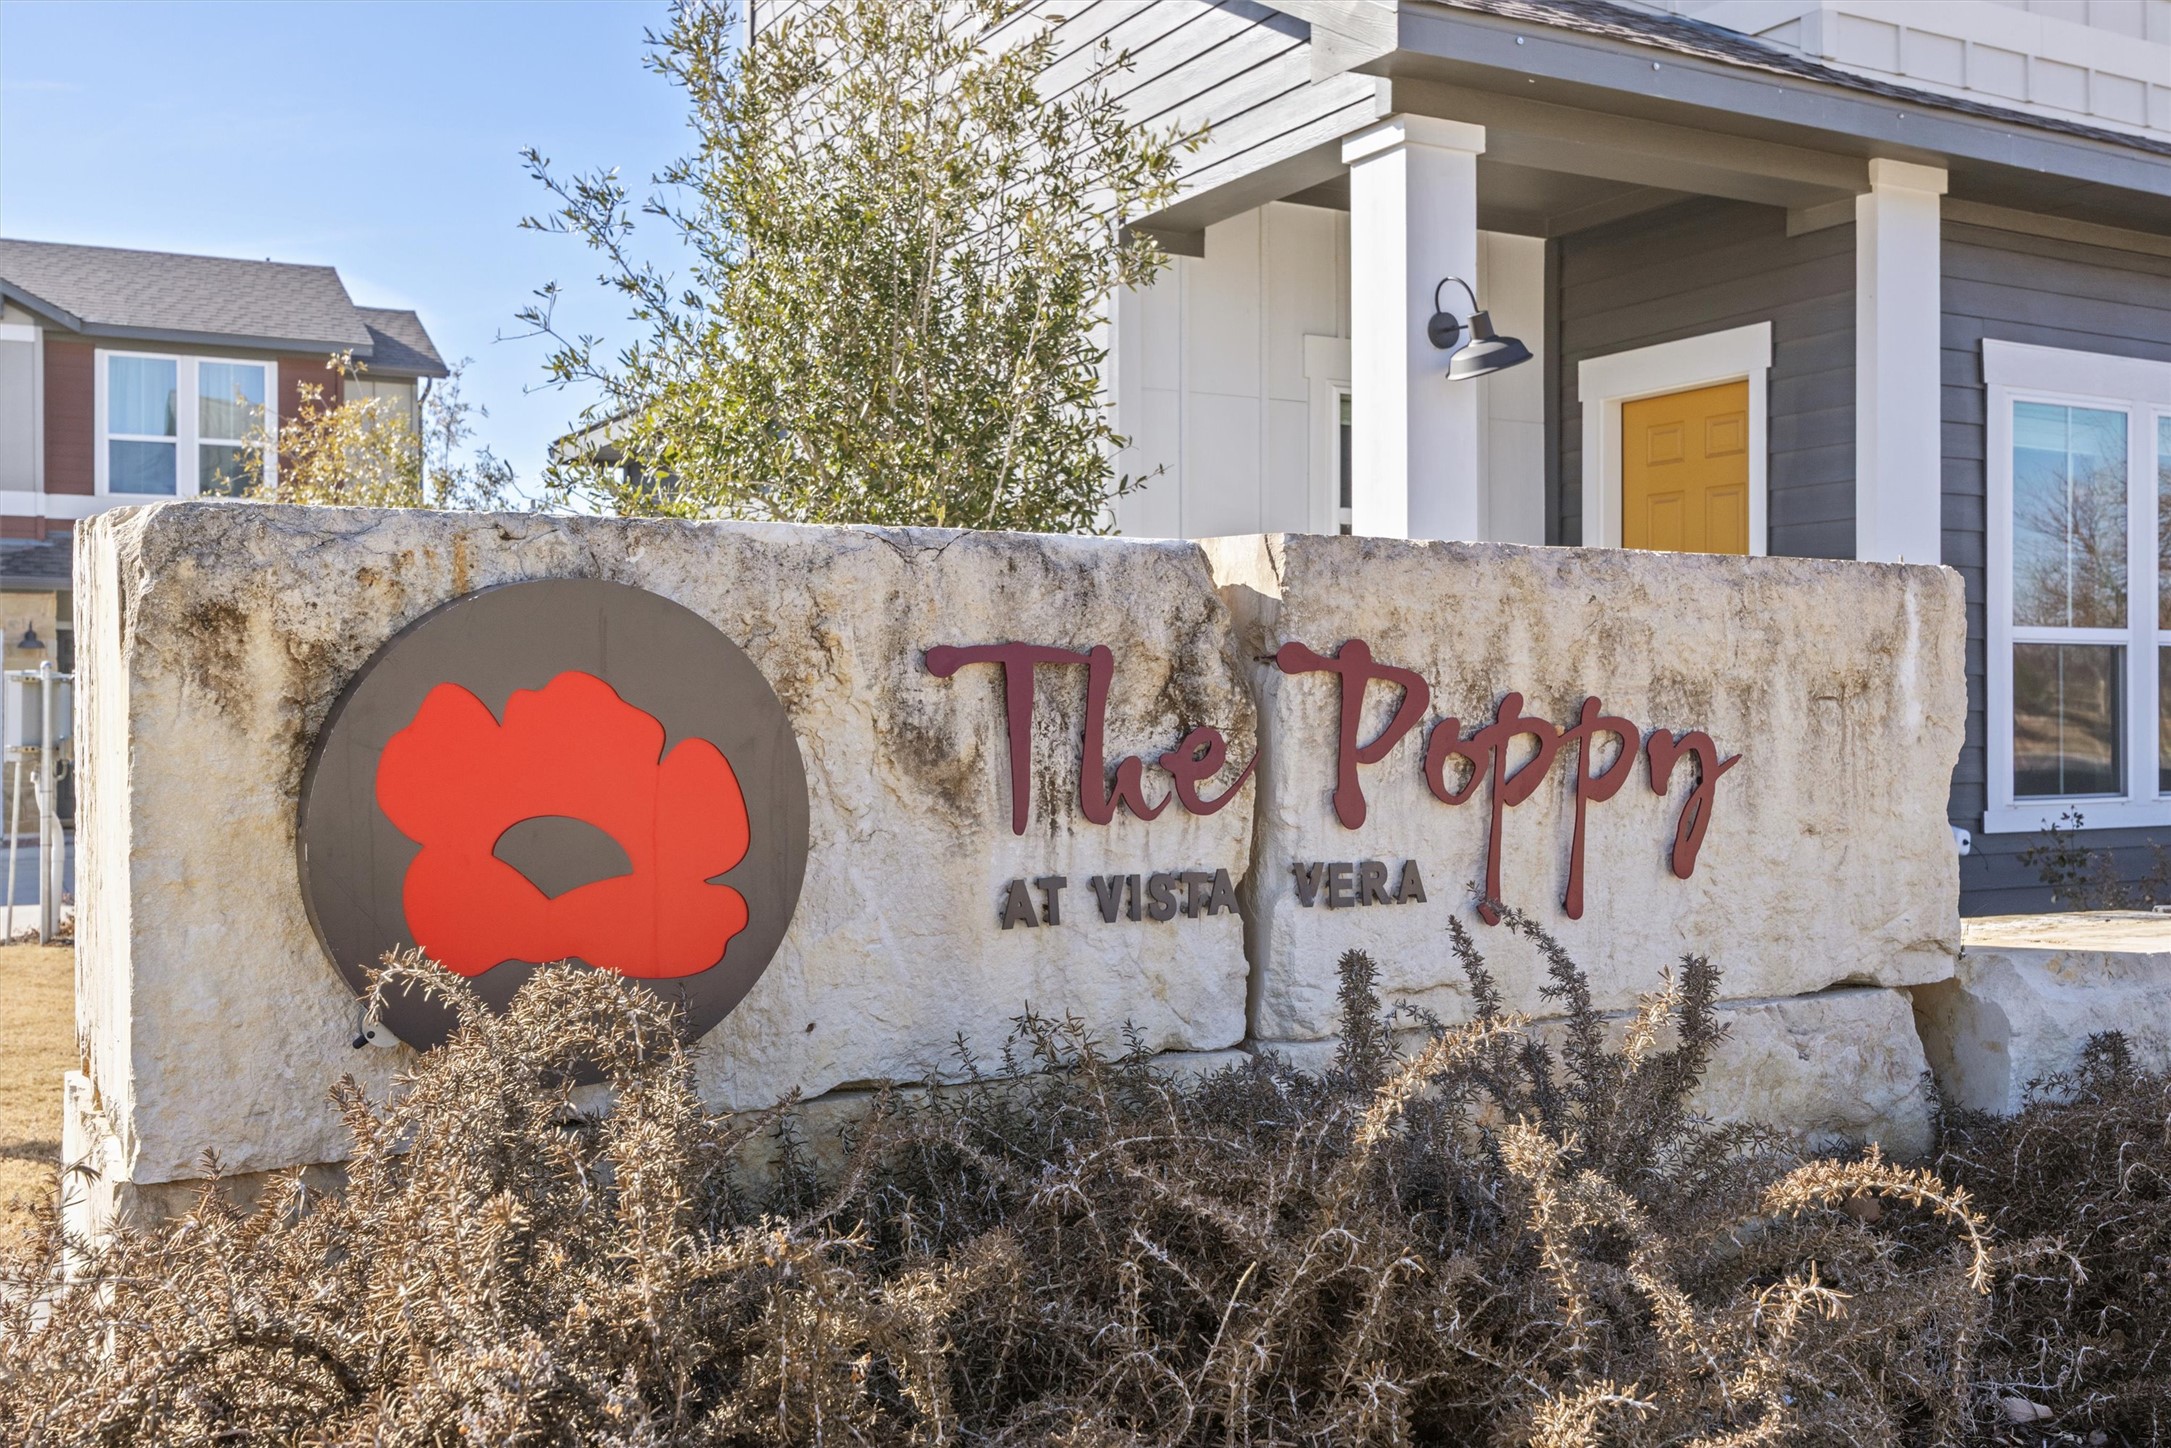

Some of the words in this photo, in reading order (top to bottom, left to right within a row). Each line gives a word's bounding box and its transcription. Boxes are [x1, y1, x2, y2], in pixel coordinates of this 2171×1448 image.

[925, 642, 1260, 836] The
[1277, 639, 1743, 926] Poppy
[1001, 876, 1068, 930] AT
[1091, 868, 1239, 923] VISTA
[1293, 860, 1428, 909] VERA
